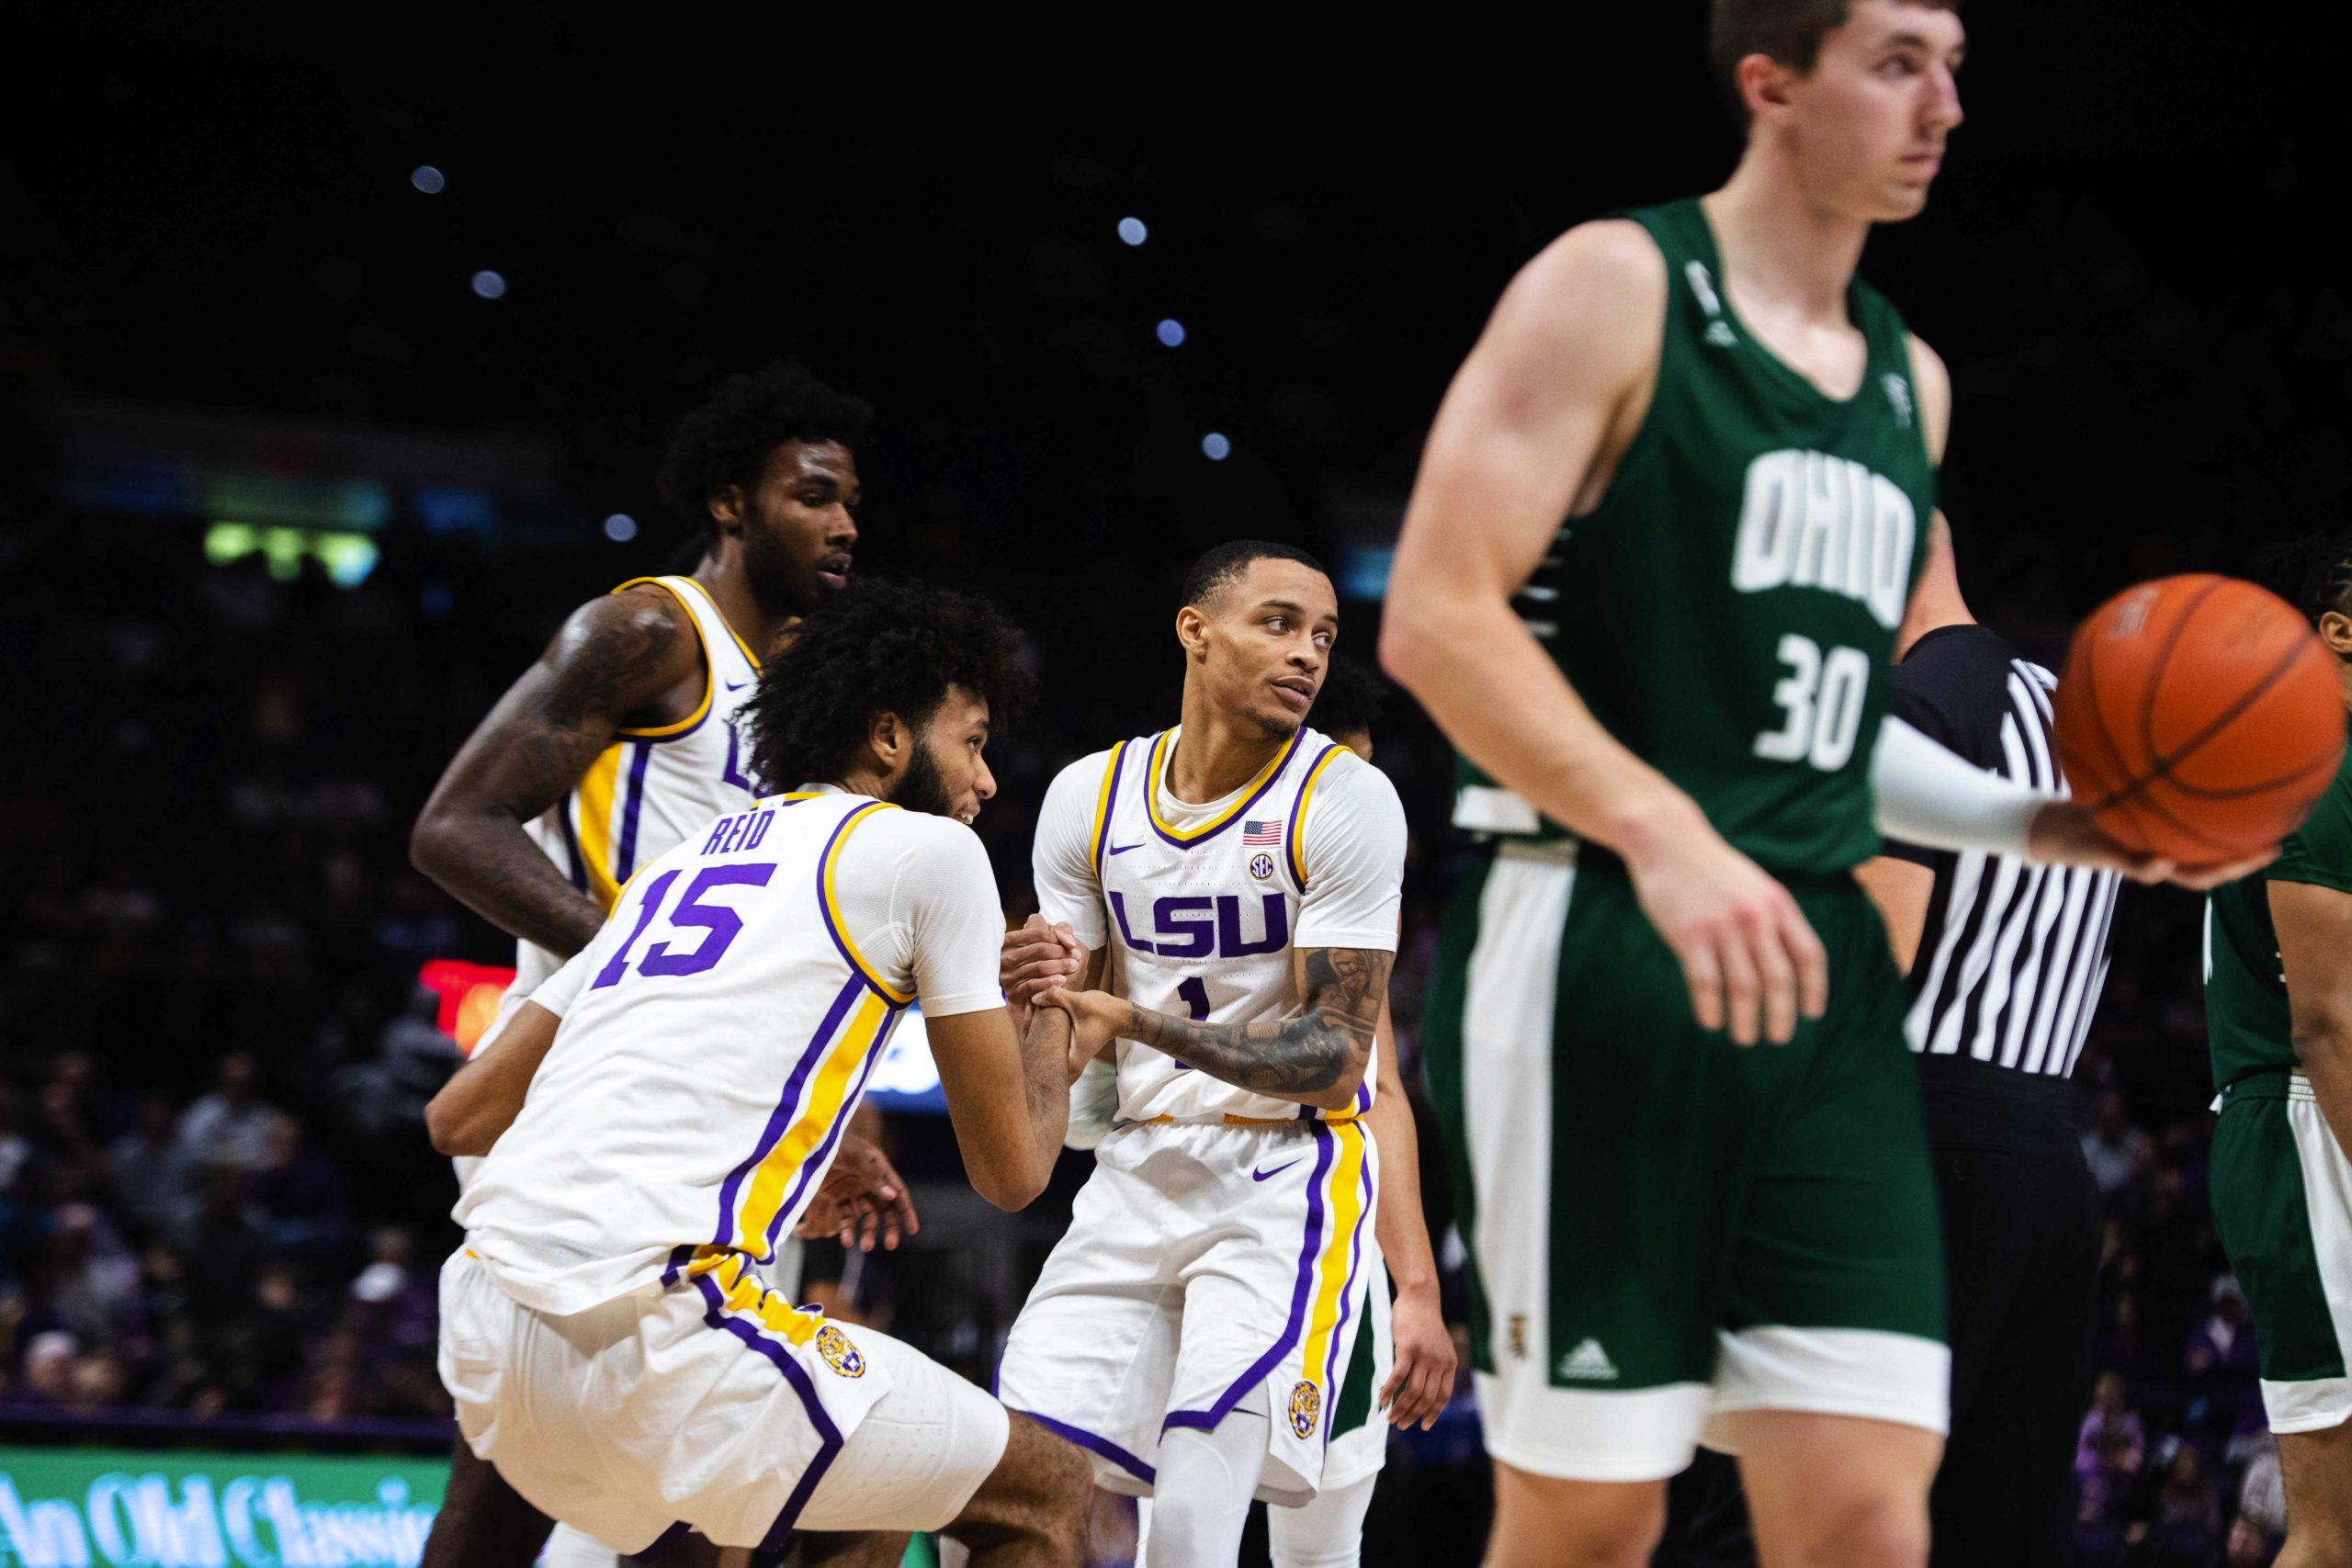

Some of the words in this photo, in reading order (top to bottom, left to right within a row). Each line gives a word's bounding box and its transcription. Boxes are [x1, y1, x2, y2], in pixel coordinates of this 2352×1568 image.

[1731, 448, 1917, 630] OHIO
[1751, 633, 1870, 773] 30
[700, 809, 775, 855] REID
[1250, 854, 1272, 878] SEC
[591, 863, 777, 990] 15
[1109, 892, 1288, 958] LSU
[1175, 976, 1210, 1069] 1
